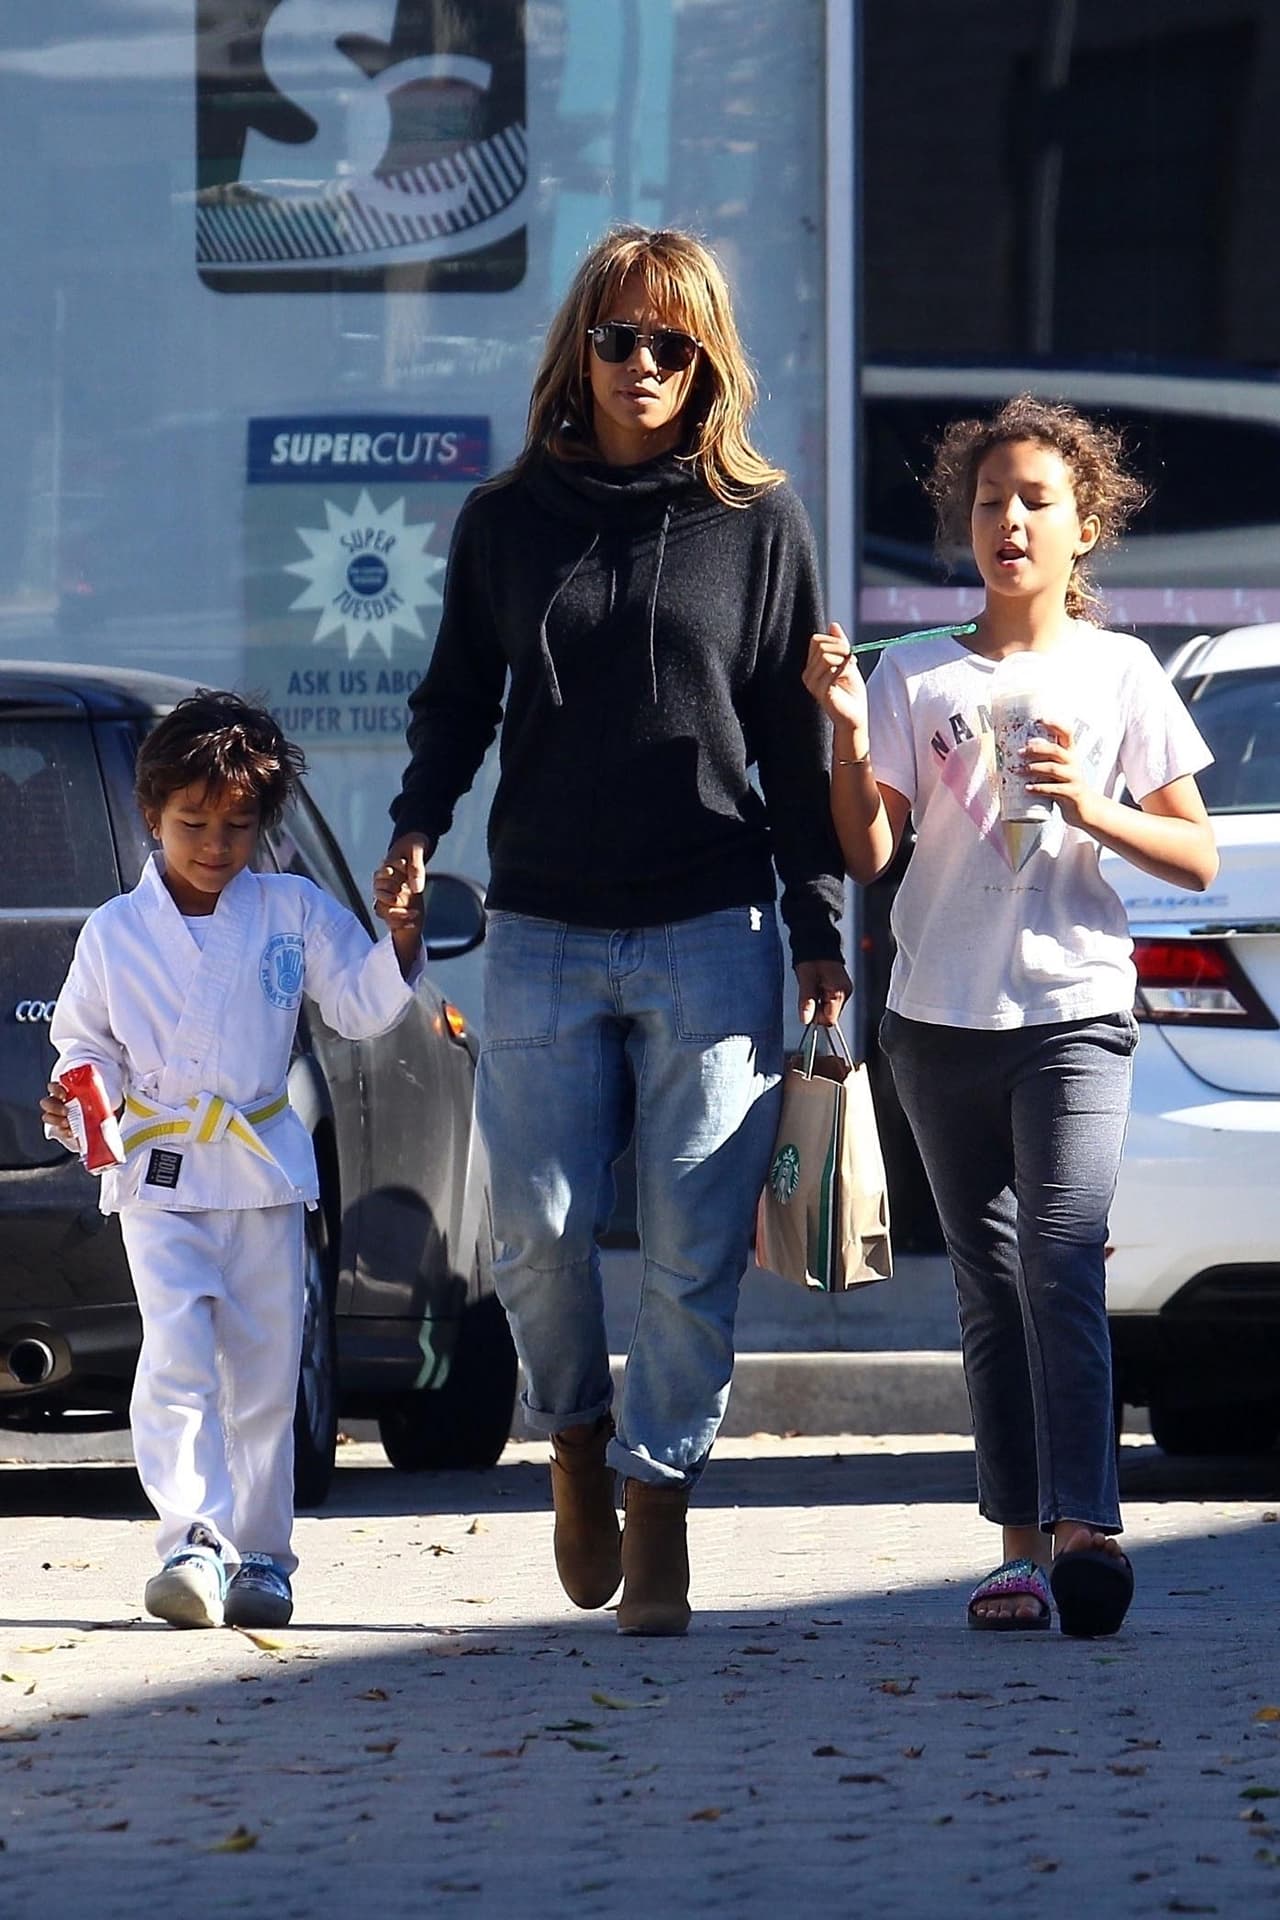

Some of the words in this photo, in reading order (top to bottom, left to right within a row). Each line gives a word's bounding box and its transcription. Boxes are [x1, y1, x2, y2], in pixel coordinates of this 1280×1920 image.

[269, 431, 460, 466] SUPERCUTS
[340, 527, 396, 554] SUPER
[332, 588, 404, 621] TUESDAY
[287, 670, 329, 695] ASK
[339, 670, 367, 695] US
